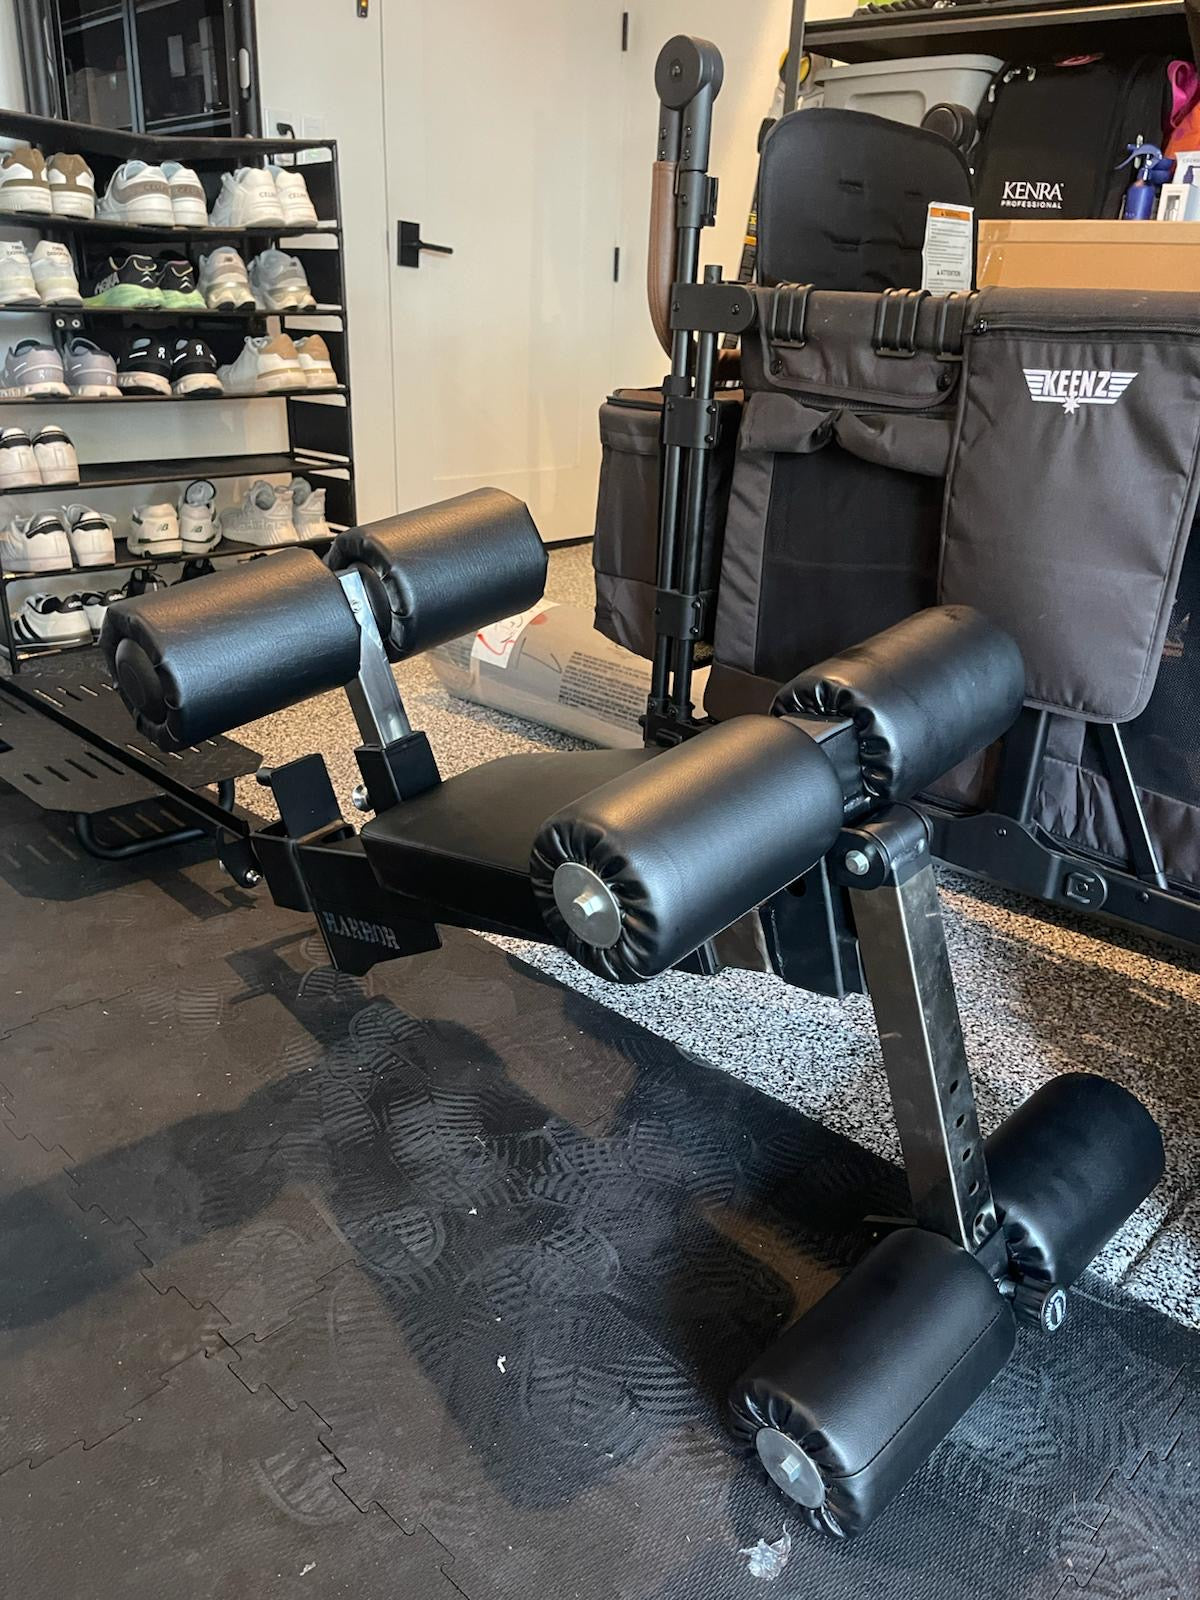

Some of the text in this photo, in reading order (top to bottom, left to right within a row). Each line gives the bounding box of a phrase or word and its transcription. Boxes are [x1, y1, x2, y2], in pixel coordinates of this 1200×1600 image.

[1002, 181, 1063, 201] KENRA
[1000, 200, 1062, 209] PROFESSIONAL
[1042, 370, 1111, 398] KEENZ
